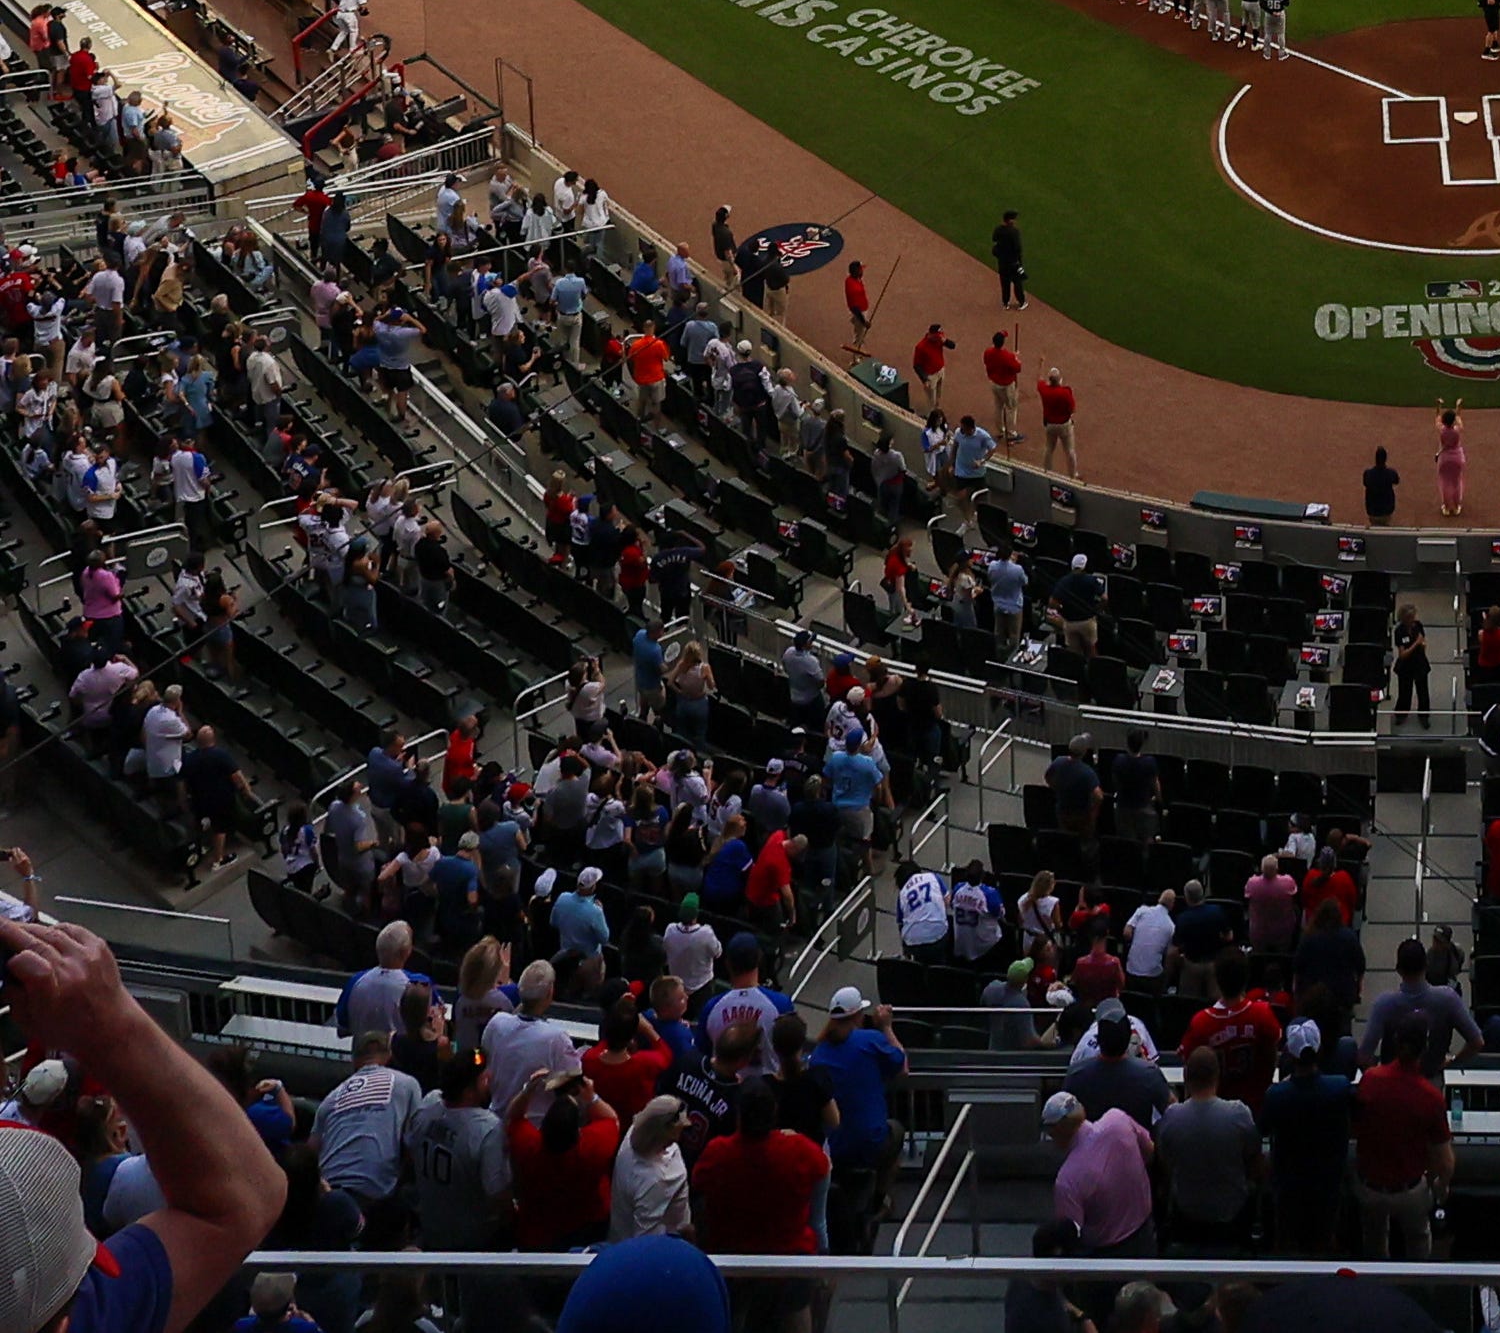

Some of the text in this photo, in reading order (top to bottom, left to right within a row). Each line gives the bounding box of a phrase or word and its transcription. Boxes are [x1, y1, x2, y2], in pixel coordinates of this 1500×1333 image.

[66, 0, 92, 26] HOME
[100, 28, 130, 51] THE
[806, 23, 1001, 116] CASINOS
[846, 7, 1042, 99] CHEROKEE
[101, 51, 250, 124] Braves
[907, 882, 931, 912] 27
[721, 1005, 763, 1024] AARON
[423, 1140, 452, 1184] 10
